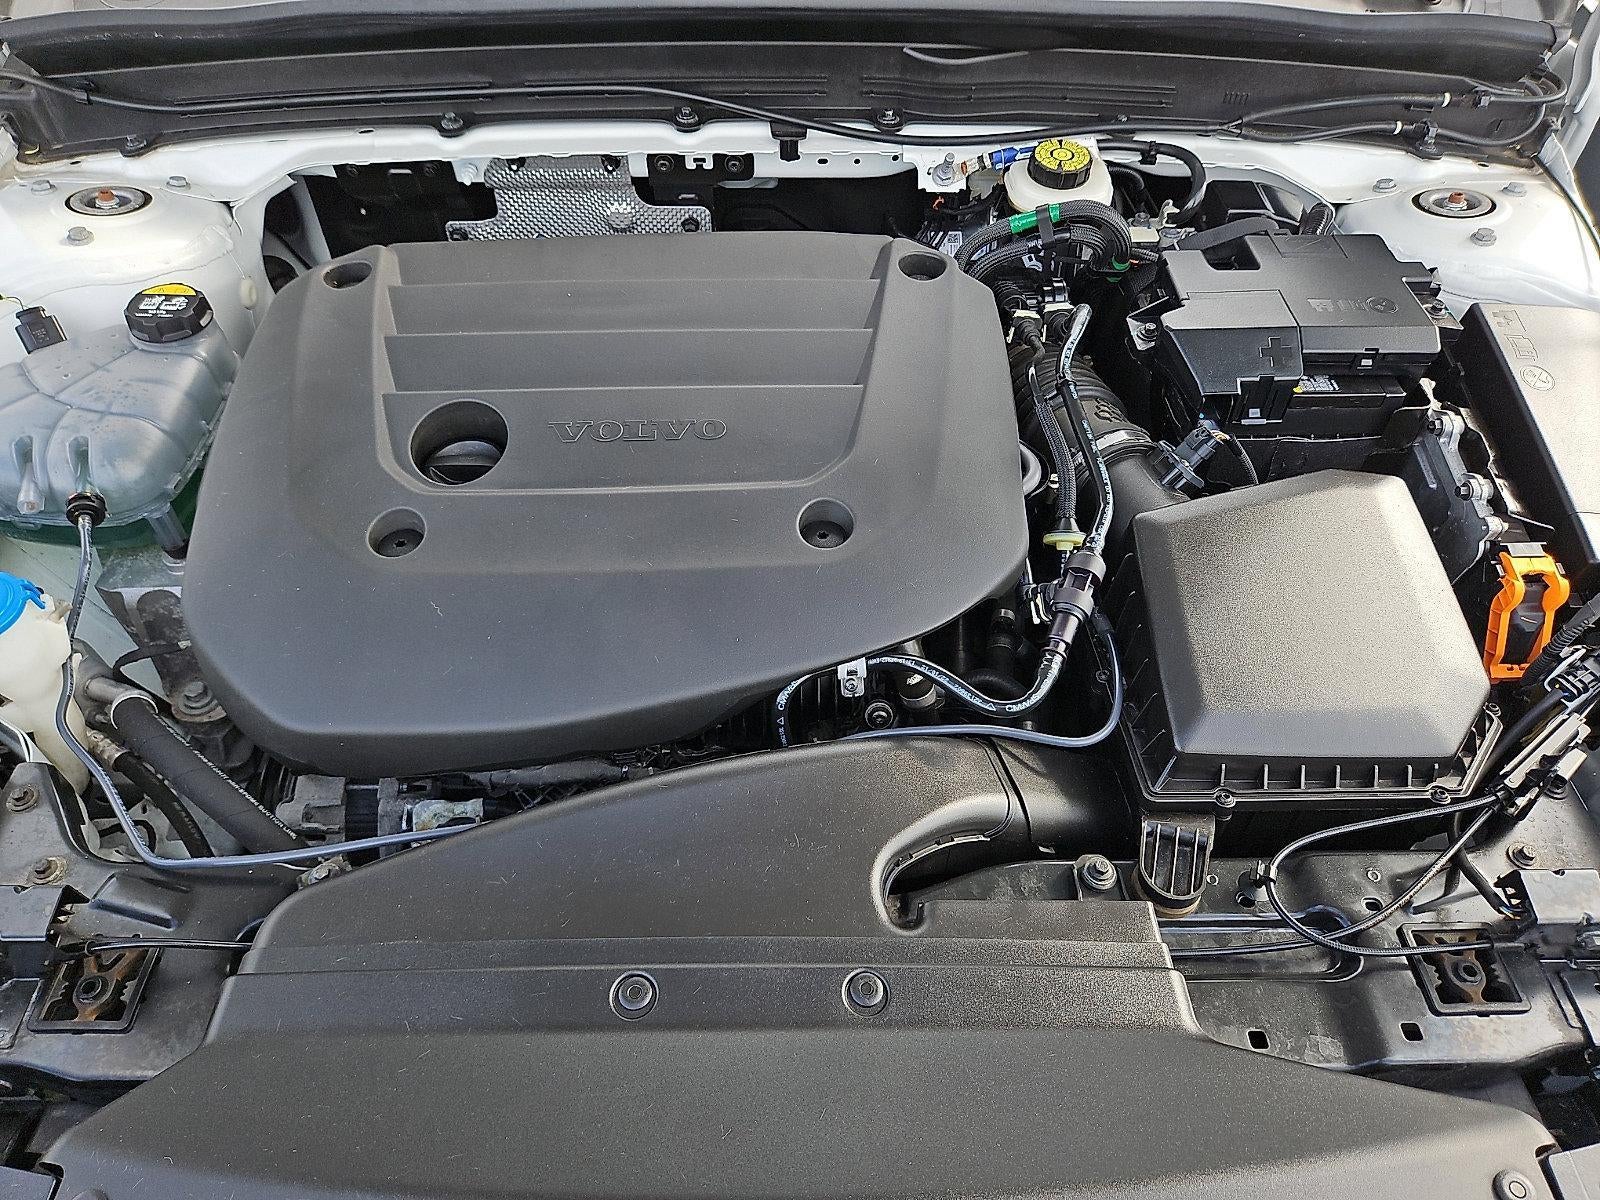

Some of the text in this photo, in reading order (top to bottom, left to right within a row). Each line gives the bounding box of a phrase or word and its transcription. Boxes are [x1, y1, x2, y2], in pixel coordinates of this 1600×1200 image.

[548, 418, 727, 443] VOLVO
[258, 804, 298, 840] SUCTION LINE
